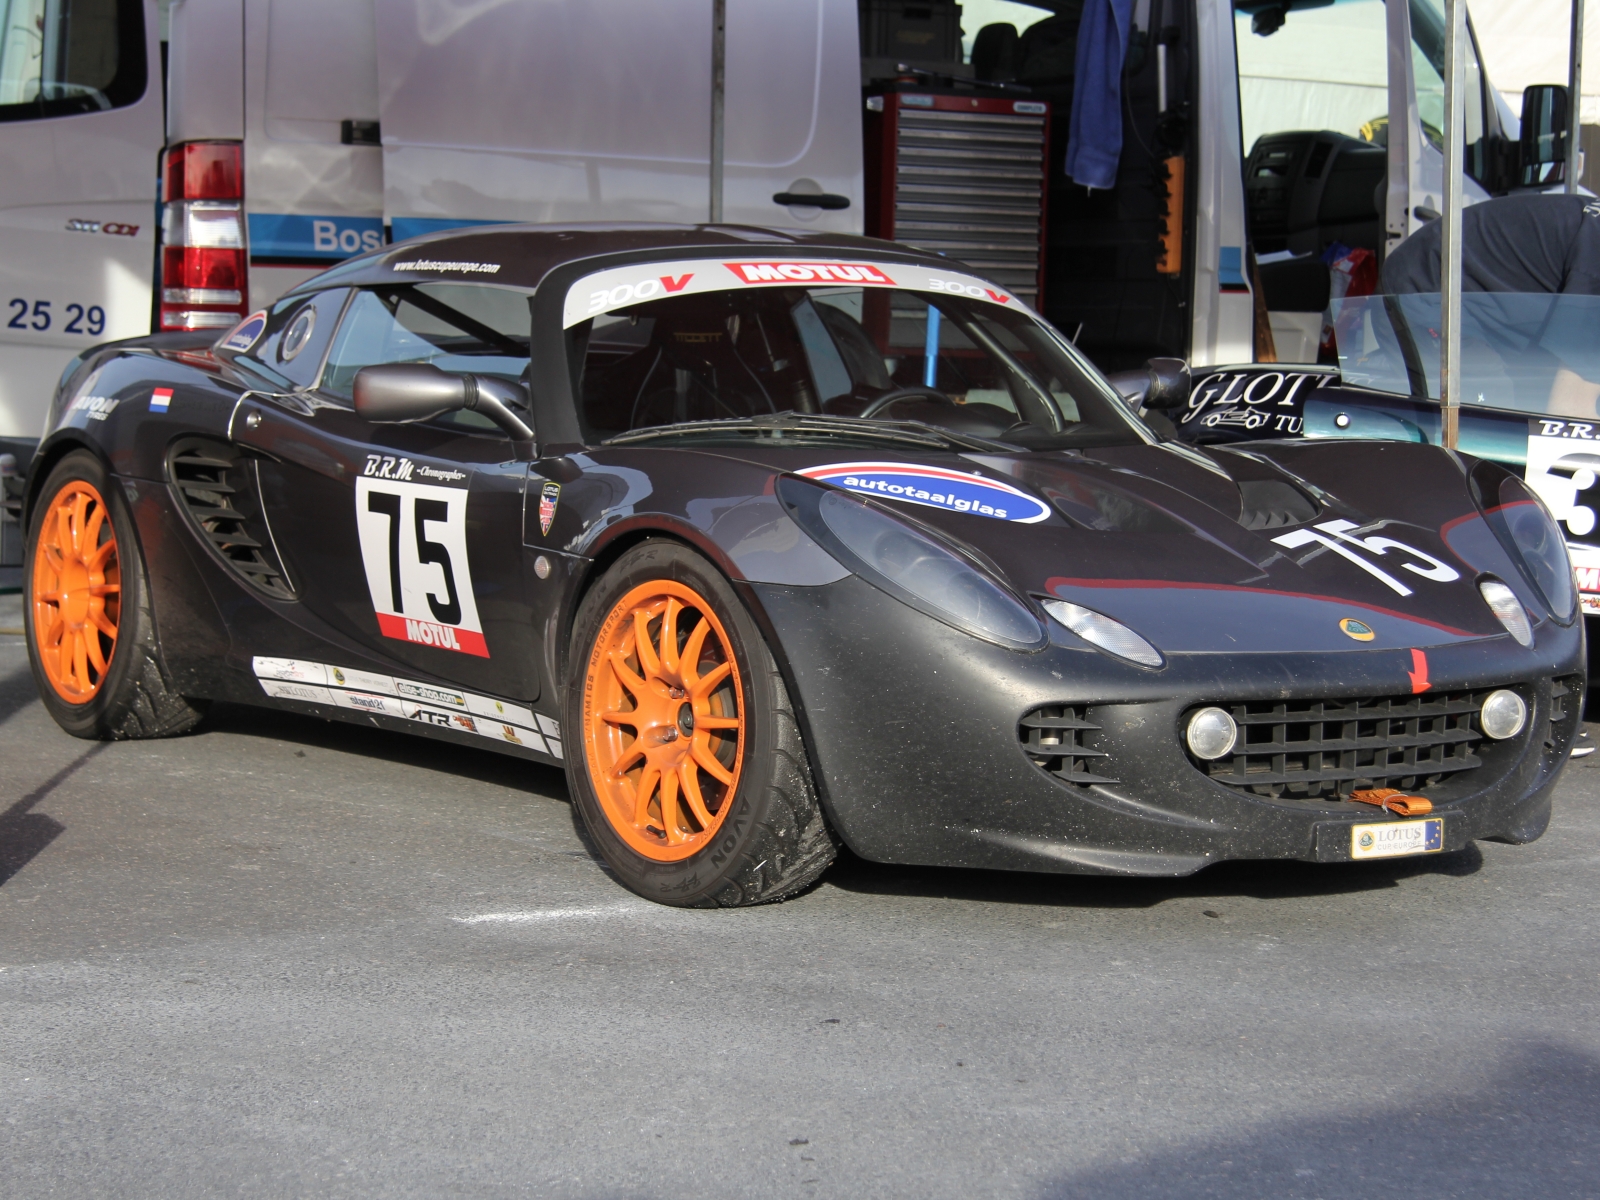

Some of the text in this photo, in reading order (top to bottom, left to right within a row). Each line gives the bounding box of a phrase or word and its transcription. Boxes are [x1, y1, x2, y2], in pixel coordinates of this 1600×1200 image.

[102, 222, 140, 237] CDI
[393, 259, 501, 274] www.lotuscupeurope.com
[740, 264, 887, 283] MOTUL
[588, 273, 695, 314] 300V
[928, 278, 1010, 304] 300V
[7, 298, 106, 336] 25 29
[72, 395, 120, 414] AVON
[1274, 414, 1303, 435] TU
[843, 476, 1008, 519] autotaalglas
[367, 490, 462, 625] 75
[1271, 517, 1460, 598] 75
[1576, 567, 1600, 590] M
[405, 618, 462, 651] MOTUL
[591, 599, 630, 667] MOTORSPORT
[408, 709, 452, 727] ATR
[710, 795, 752, 870] AVON
[1378, 827, 1422, 842] LOTUS
[1377, 843, 1392, 851] CUP
